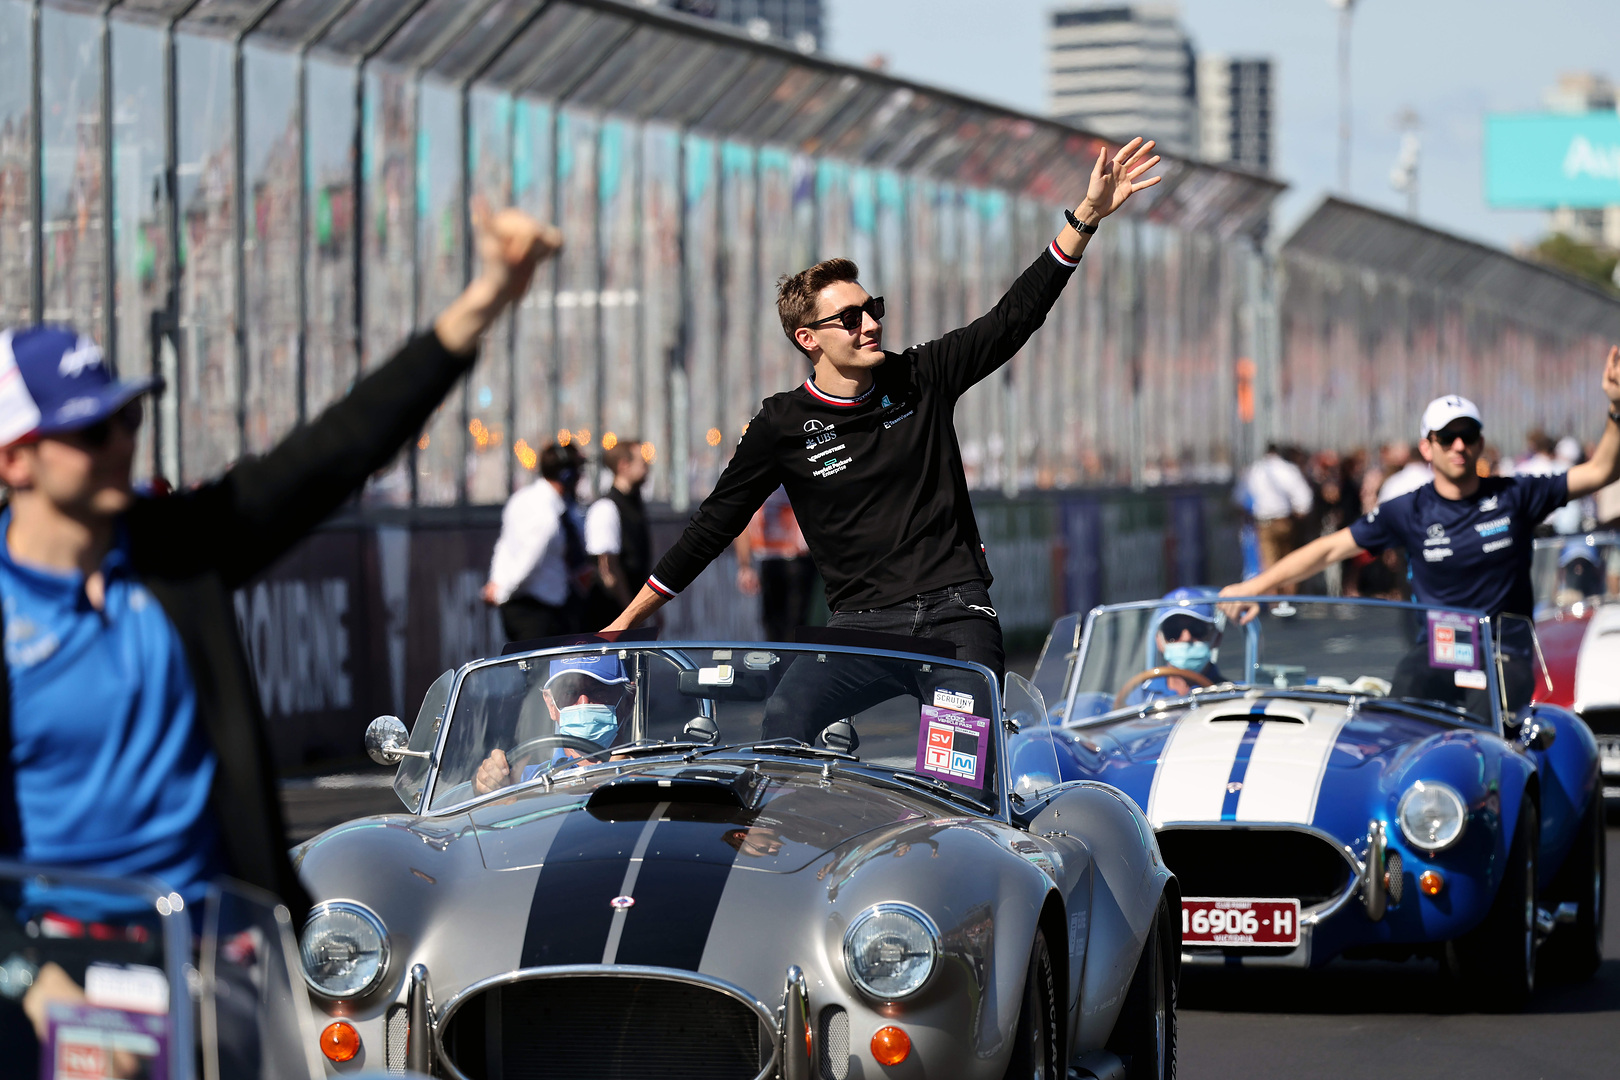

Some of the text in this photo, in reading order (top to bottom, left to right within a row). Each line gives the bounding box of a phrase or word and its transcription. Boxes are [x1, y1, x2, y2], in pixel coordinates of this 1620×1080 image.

[816, 430, 837, 445] UBS
[936, 693, 972, 707] SCRUTINY
[938, 716, 959, 726] VEHICLE
[959, 721, 973, 729] PASS
[945, 714, 966, 722] 2022
[931, 733, 951, 744] SV
[932, 751, 972, 770] T M
[1213, 934, 1254, 942] VICTORIA
